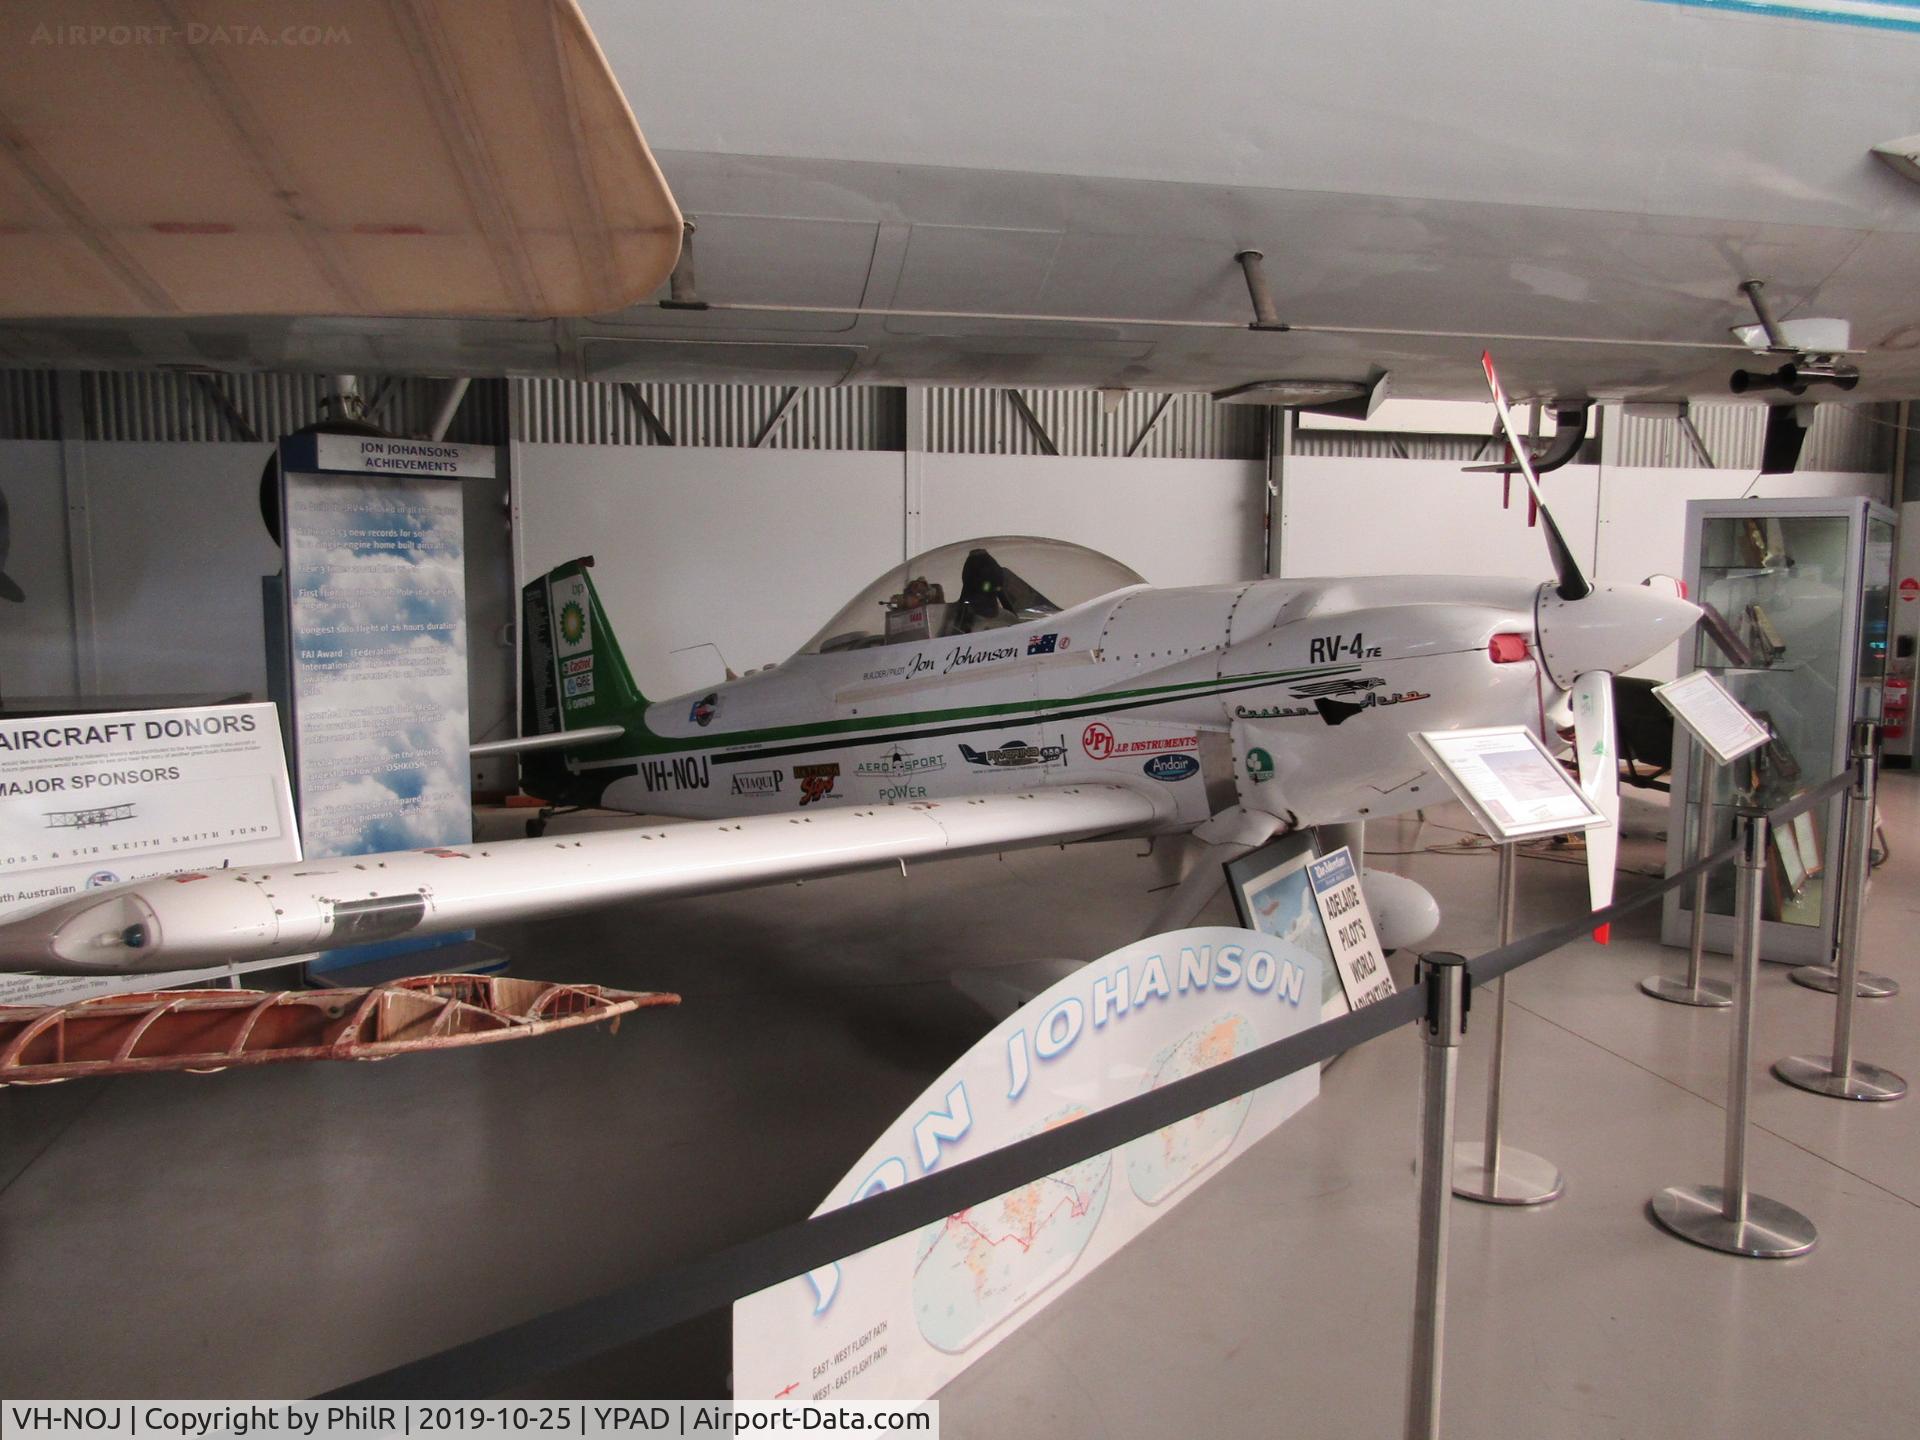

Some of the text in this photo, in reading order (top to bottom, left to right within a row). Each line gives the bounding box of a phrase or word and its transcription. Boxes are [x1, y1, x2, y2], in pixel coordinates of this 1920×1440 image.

[361, 442, 459, 458] JON JOHANSONS
[366, 457, 457, 472] ACHIEVEMENTS
[368, 529, 398, 537] records
[400, 529, 411, 537] for
[374, 541, 394, 549] home
[398, 540, 414, 549] built
[299, 588, 318, 597] First
[300, 626, 335, 636] Longest
[357, 624, 379, 634] flight
[380, 624, 389, 632] of
[427, 622, 457, 630] duration
[302, 651, 314, 659] FAI
[317, 649, 342, 658] Award
[1310, 632, 1382, 664] RV-4 TE
[906, 652, 934, 679] Jon
[944, 646, 1018, 674] Johanson
[0, 714, 256, 751] AIRCRAFT DONORS
[1085, 728, 1112, 754] JPI
[1131, 736, 1198, 751] INSTRUMENTS
[641, 755, 709, 791] VH-NOJ
[858, 755, 944, 773] AERO SPORT
[1153, 755, 1189, 771] Andair
[71, 766, 180, 790] SPONSORS
[880, 785, 927, 800] POWER
[73, 847, 100, 857] SIR
[112, 839, 161, 851] KEITH
[172, 831, 220, 844] SMITH
[230, 825, 269, 837] FUND
[18, 885, 76, 900] Australian
[1325, 884, 1360, 920] ADELAIDE
[1338, 918, 1367, 951] PILOT'S
[1349, 951, 1377, 985] WORLD
[1005, 944, 1307, 1102] JOHANSON
[812, 1359, 830, 1380] EAST
[834, 1344, 851, 1365] WEST
[852, 1330, 873, 1353] FLIGHT
[873, 1319, 887, 1338] PATH
[835, 1370, 851, 1390] EAST
[852, 1354, 873, 1377] FLIGHT
[873, 1343, 887, 1363] PATH
